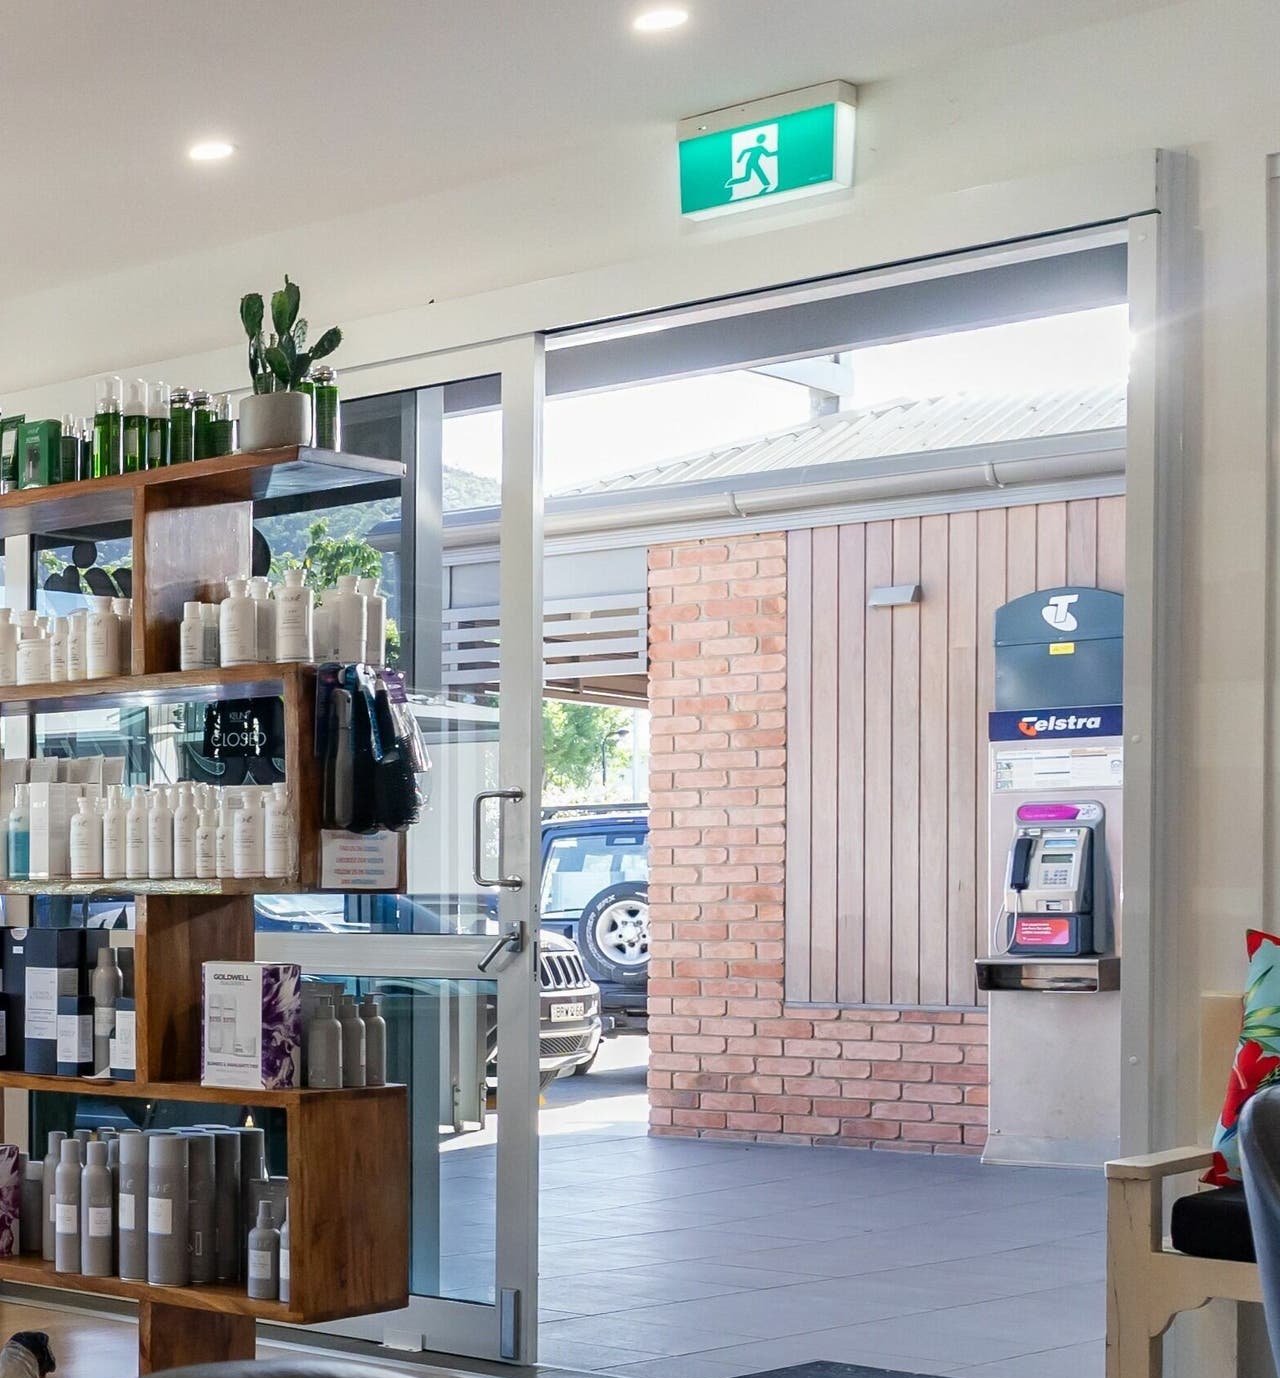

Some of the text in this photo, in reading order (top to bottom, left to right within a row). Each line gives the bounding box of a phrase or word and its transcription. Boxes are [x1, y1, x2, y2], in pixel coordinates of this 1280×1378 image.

[1018, 715, 1101, 737] Telstra
[210, 731, 267, 747] CLOSED
[213, 973, 252, 982] GOLDWELL
